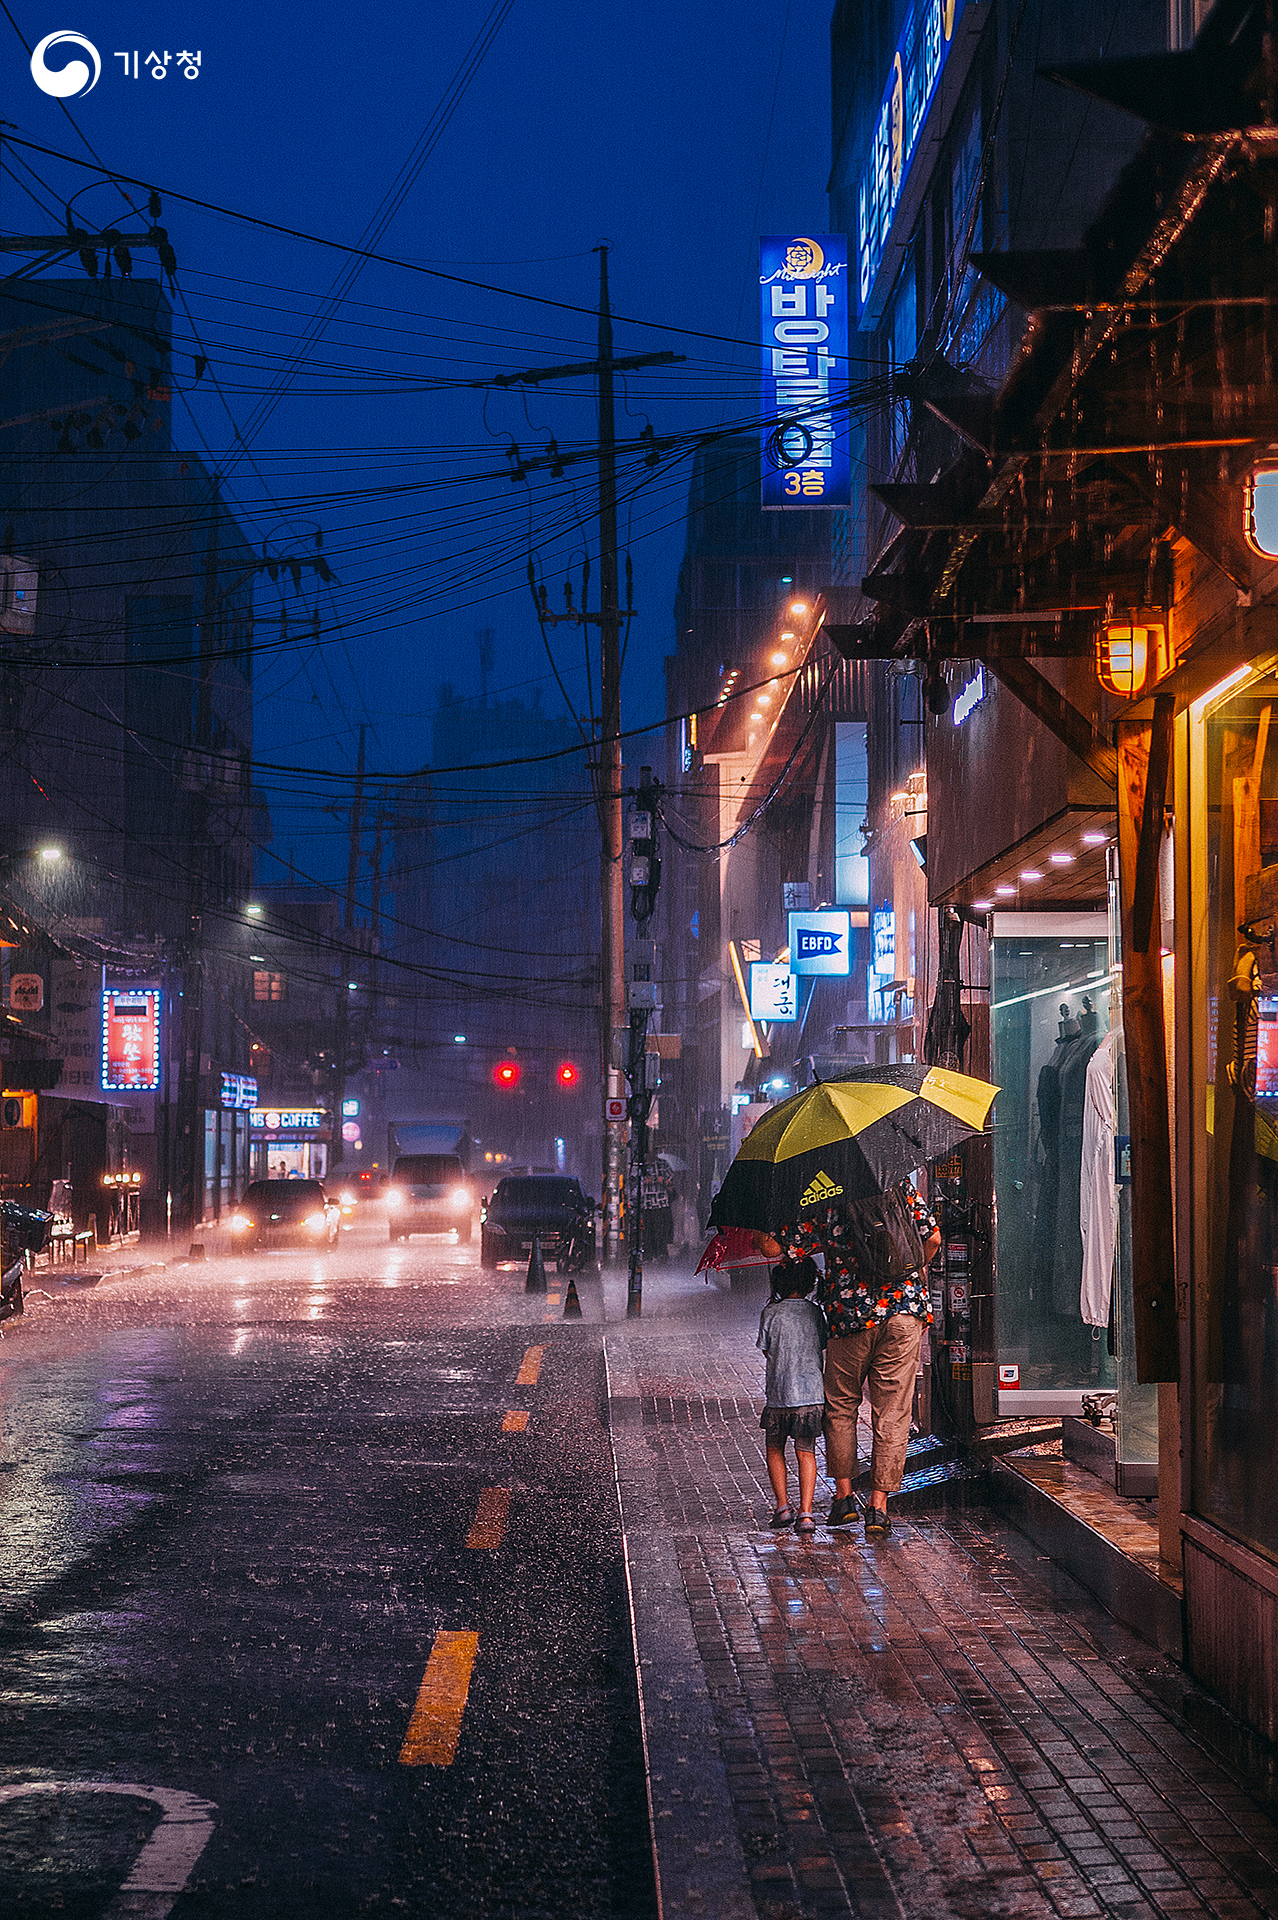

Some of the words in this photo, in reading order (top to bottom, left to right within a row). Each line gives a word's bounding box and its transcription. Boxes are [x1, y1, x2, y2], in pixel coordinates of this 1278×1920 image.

[784, 470, 825, 495] 3층
[802, 936, 832, 950] EBFD
[281, 1113, 320, 1127] COFFEE
[800, 1185, 844, 1206] adidas
